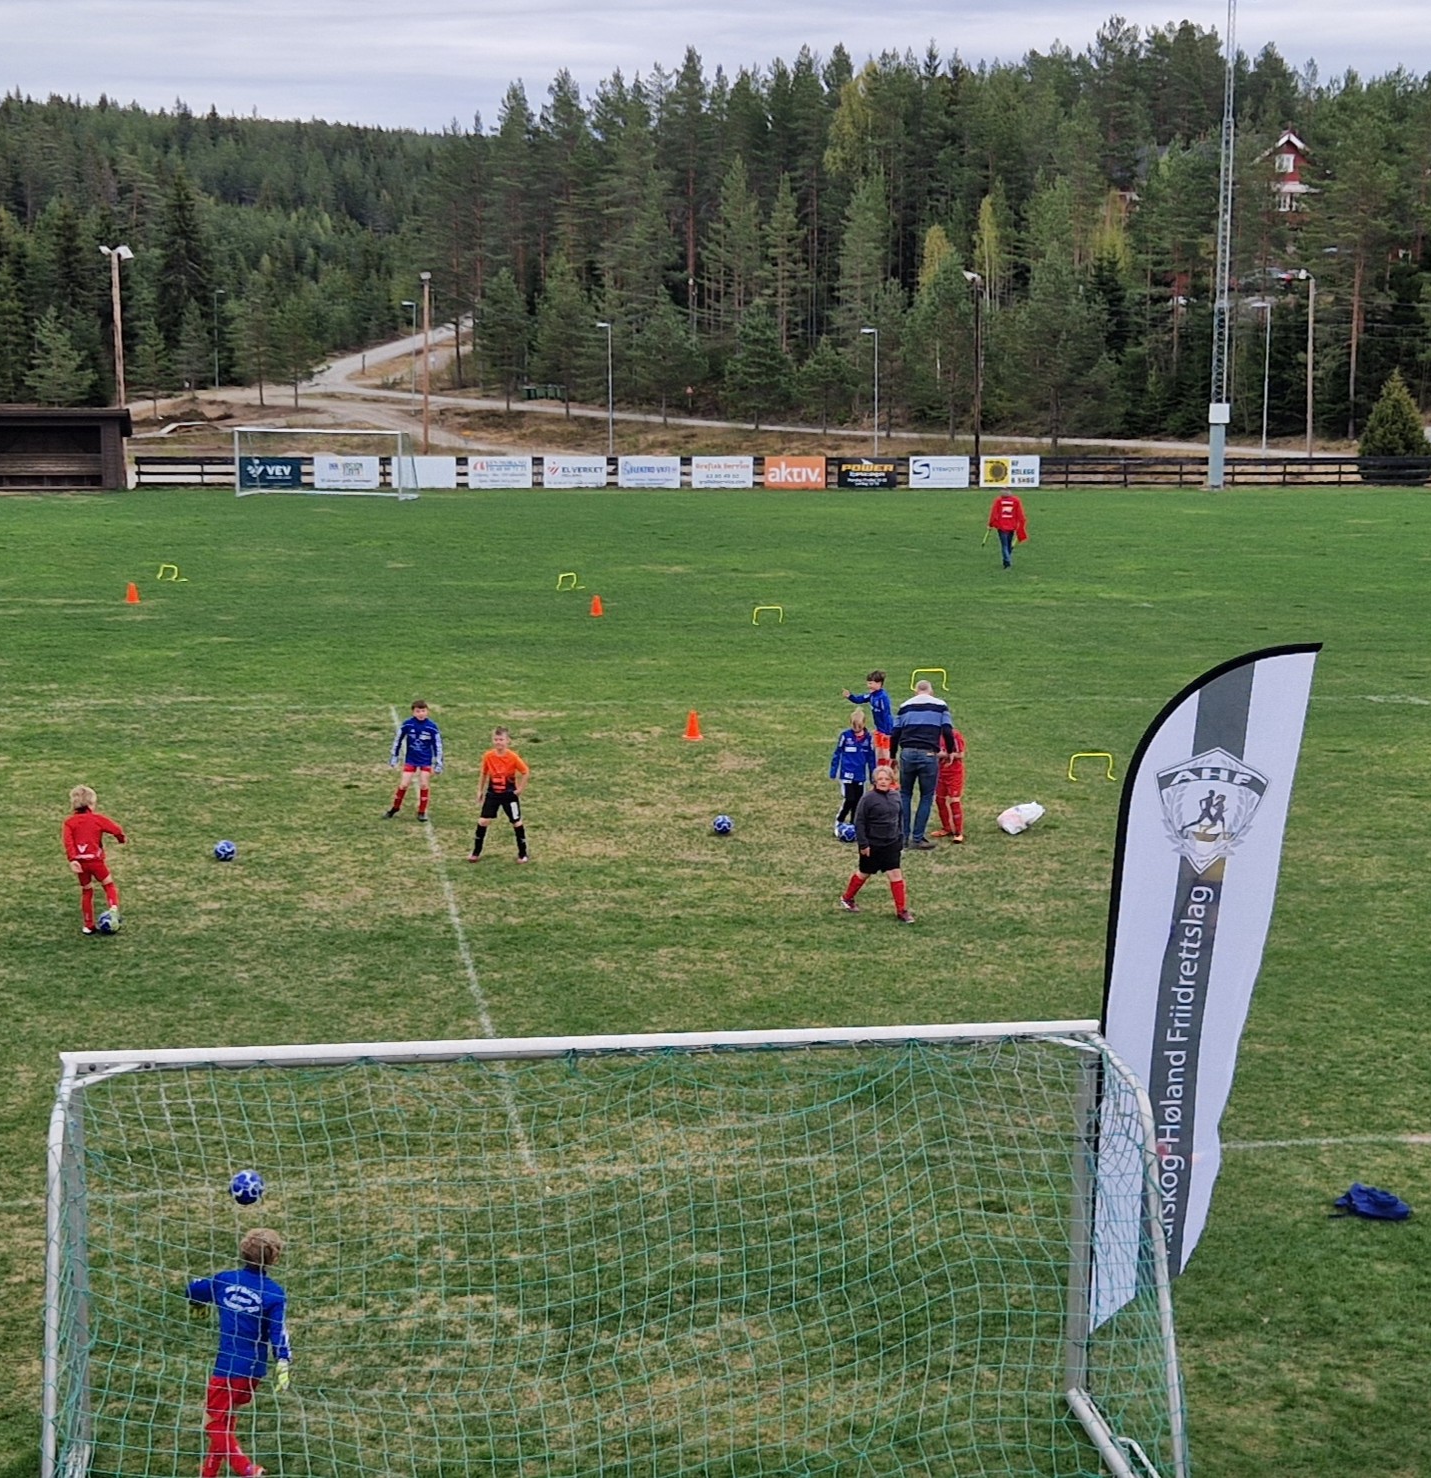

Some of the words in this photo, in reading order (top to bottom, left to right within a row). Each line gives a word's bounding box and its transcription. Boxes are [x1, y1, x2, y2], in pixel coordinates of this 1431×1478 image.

[265, 464, 292, 476] VEV
[841, 463, 895, 472] POWER
[1170, 767, 1253, 786] AHF
[1166, 886, 1214, 1042] Friidrettslag
